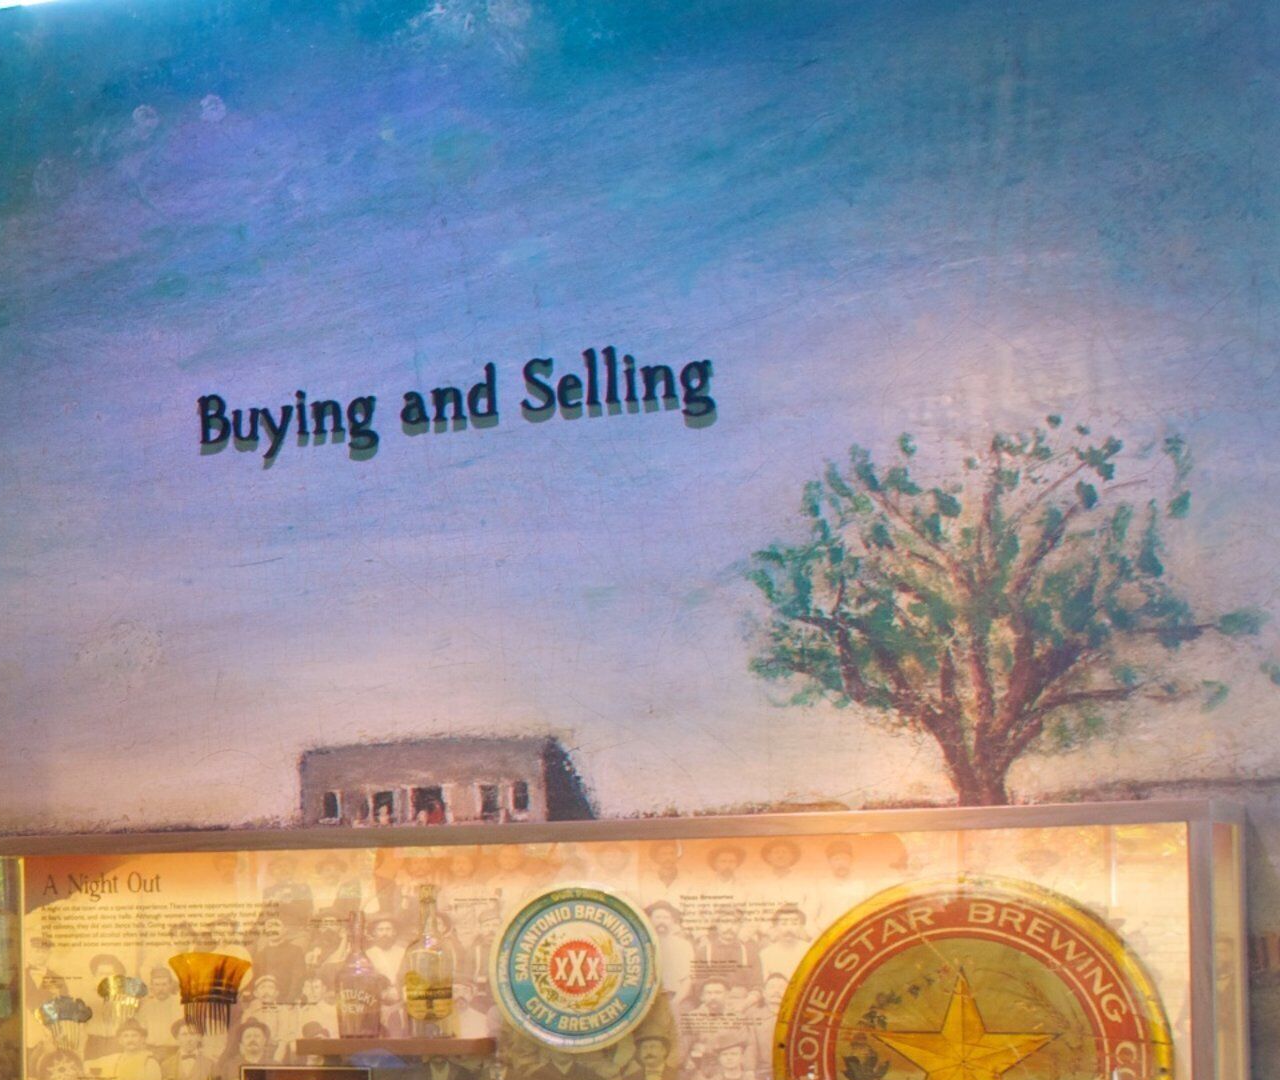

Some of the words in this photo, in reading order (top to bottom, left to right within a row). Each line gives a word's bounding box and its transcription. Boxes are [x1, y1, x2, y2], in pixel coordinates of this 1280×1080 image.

[197, 390, 378, 462] Buying
[400, 362, 498, 430] and
[521, 346, 718, 424] Selling
[42, 874, 58, 896] A
[68, 873, 118, 901] Night
[127, 871, 162, 893] Out
[520, 906, 571, 950] ANTONIO
[574, 904, 634, 945] BREWING
[514, 953, 530, 982] SAN
[833, 904, 936, 973] STAR
[967, 903, 1129, 1024] BREWING
[526, 997, 558, 1025] CITY
